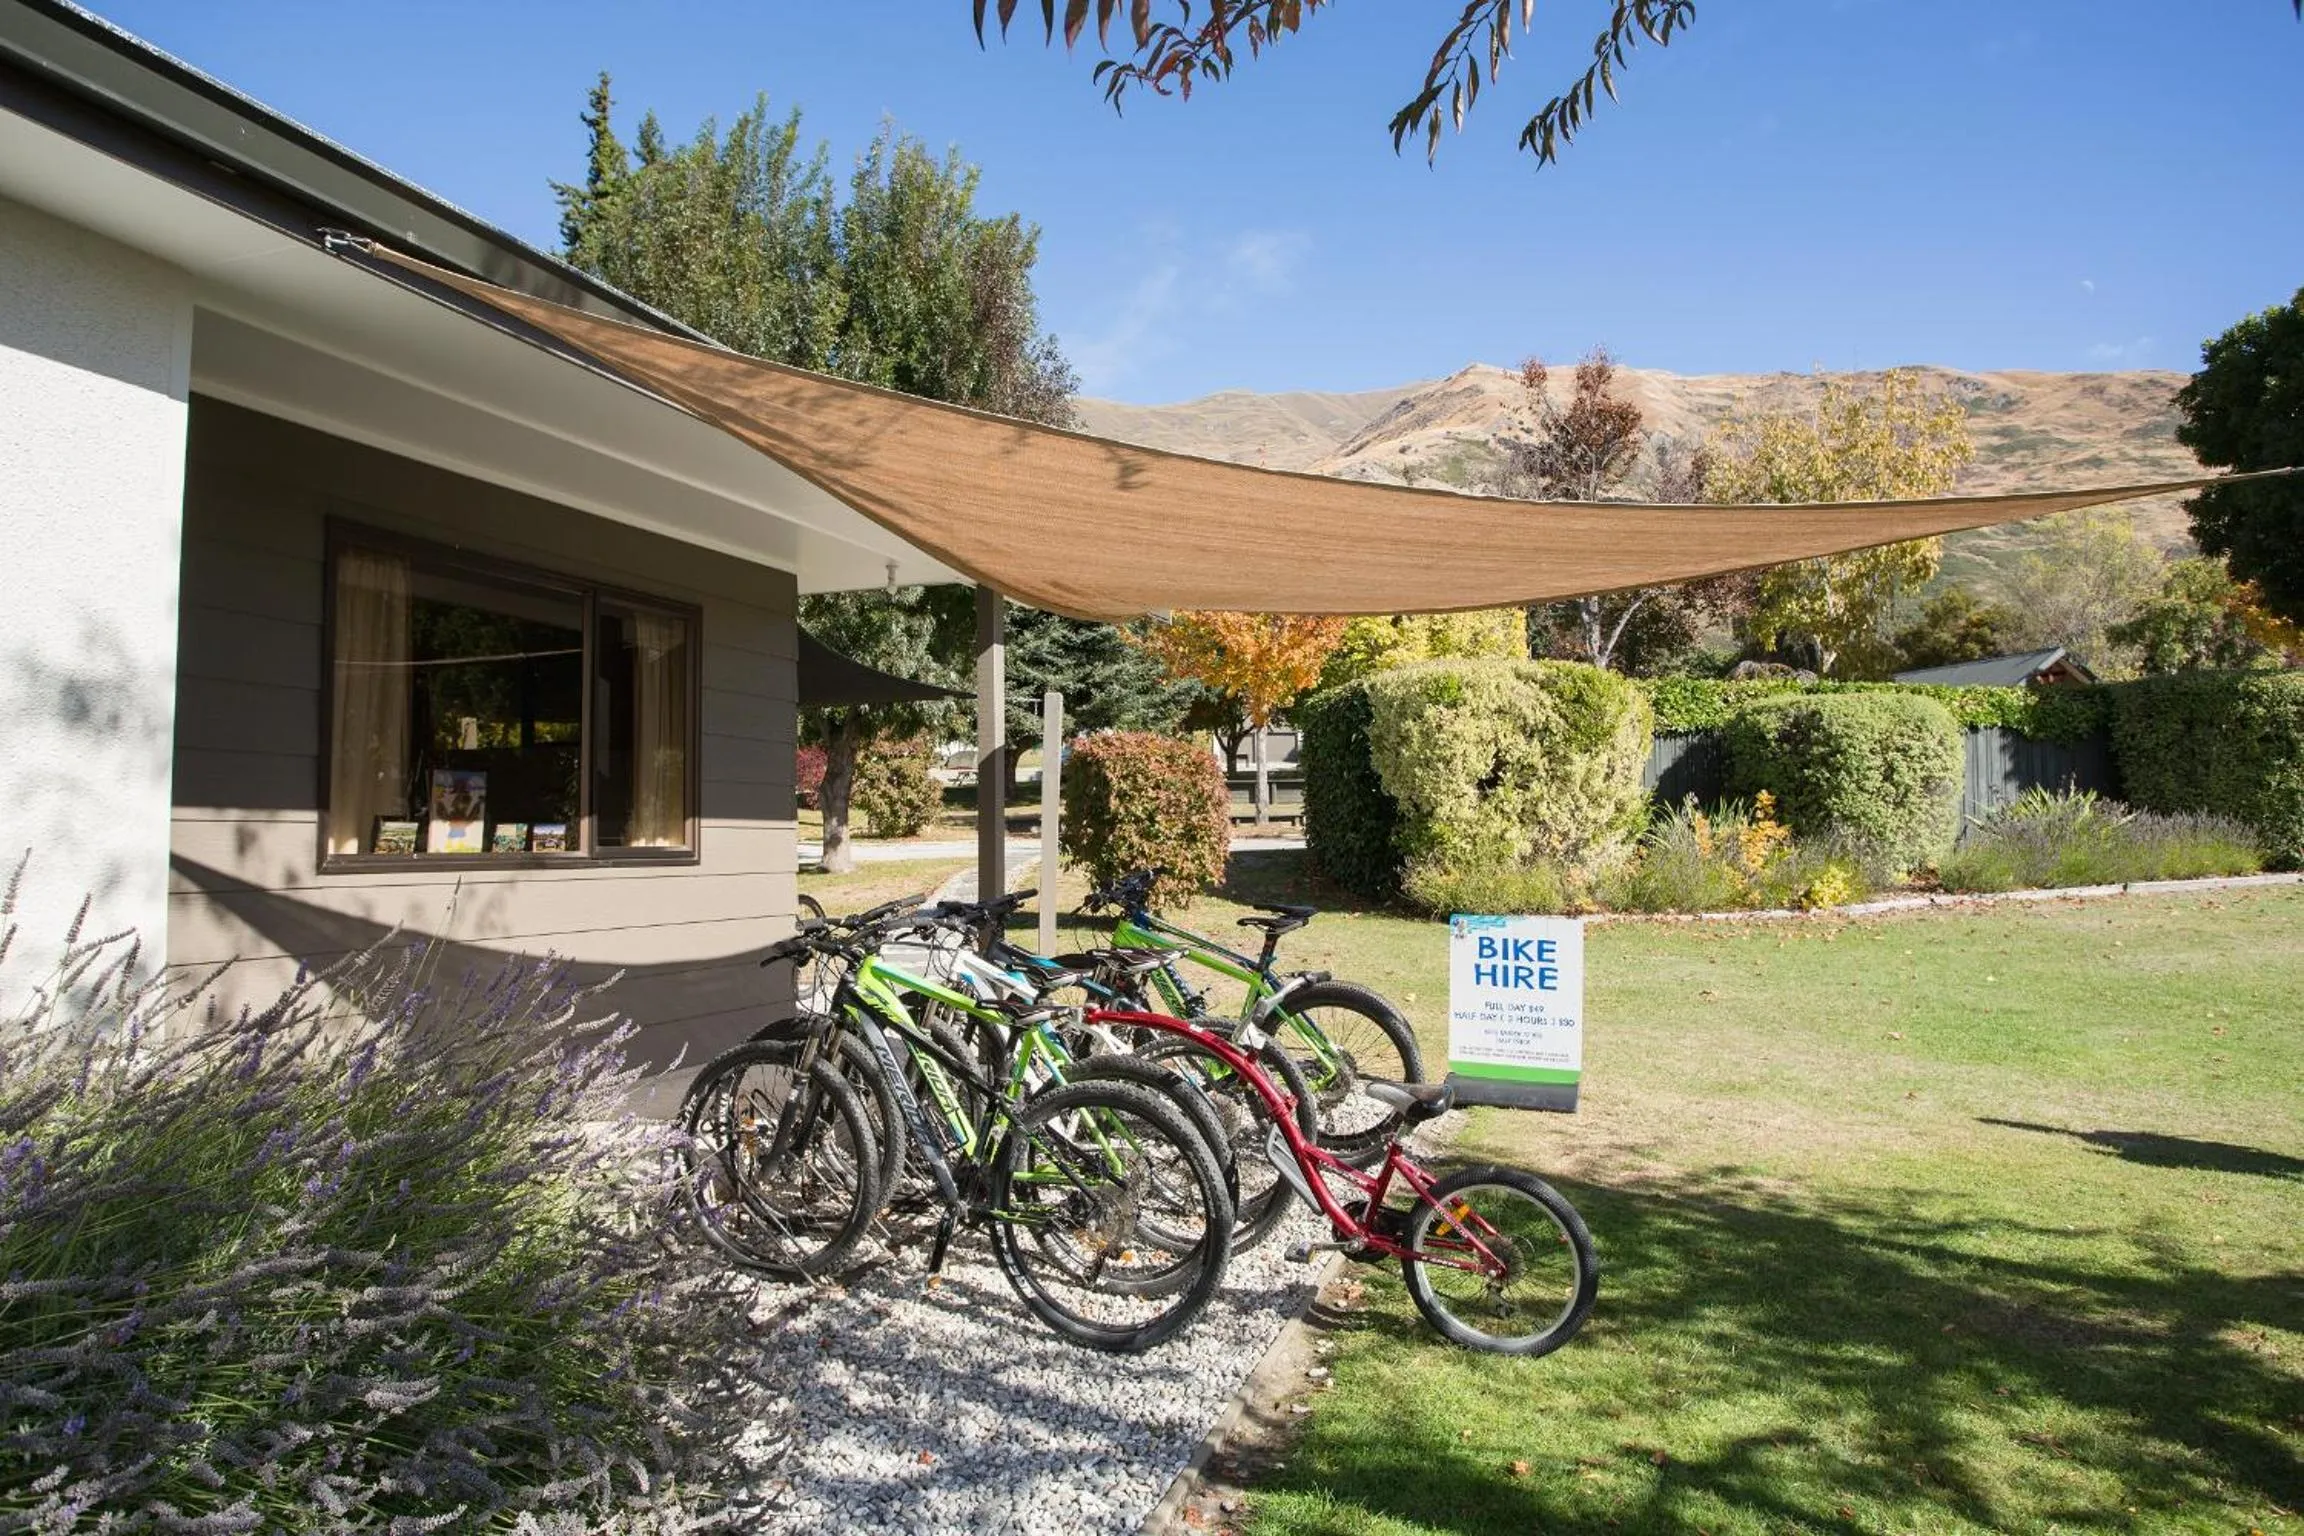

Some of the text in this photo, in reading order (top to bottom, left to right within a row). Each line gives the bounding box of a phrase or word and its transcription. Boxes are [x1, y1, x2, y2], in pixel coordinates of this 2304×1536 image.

[1478, 936, 1557, 963] BIKE
[1474, 963, 1559, 990] HIRE
[1454, 1011, 1476, 1020] HALF
[1480, 1012, 1497, 1021] DAY
[1516, 1015, 1548, 1026] HOURS
[1485, 1001, 1504, 1011] FULL
[1508, 1003, 1527, 1012] DAY
[875, 1045, 932, 1144] MERIDA
